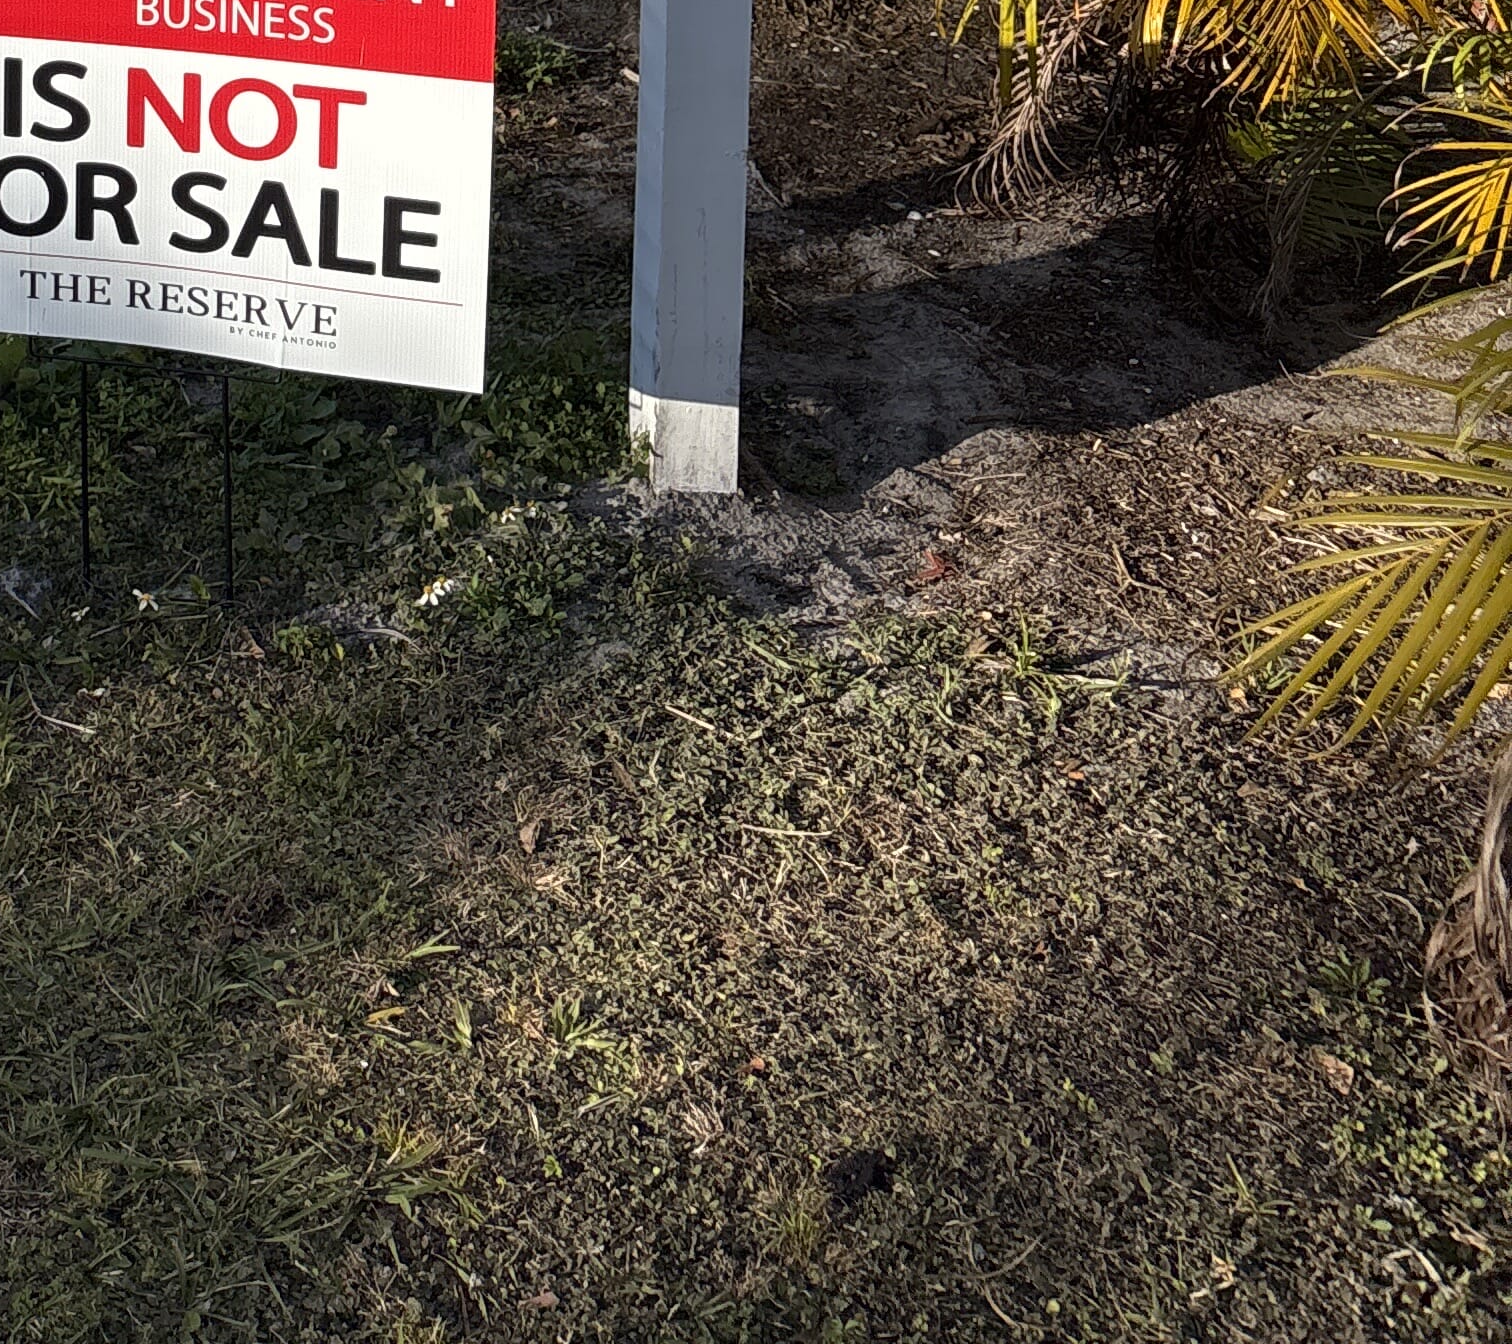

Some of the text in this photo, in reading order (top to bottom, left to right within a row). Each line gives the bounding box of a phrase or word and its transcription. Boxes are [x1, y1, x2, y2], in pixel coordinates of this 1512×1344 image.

[3, 57, 367, 169] IS NOT
[168, 171, 442, 283] SALE
[19, 269, 338, 337] THE RESERVE
[229, 325, 337, 350] BY CHEF ANTONIO
